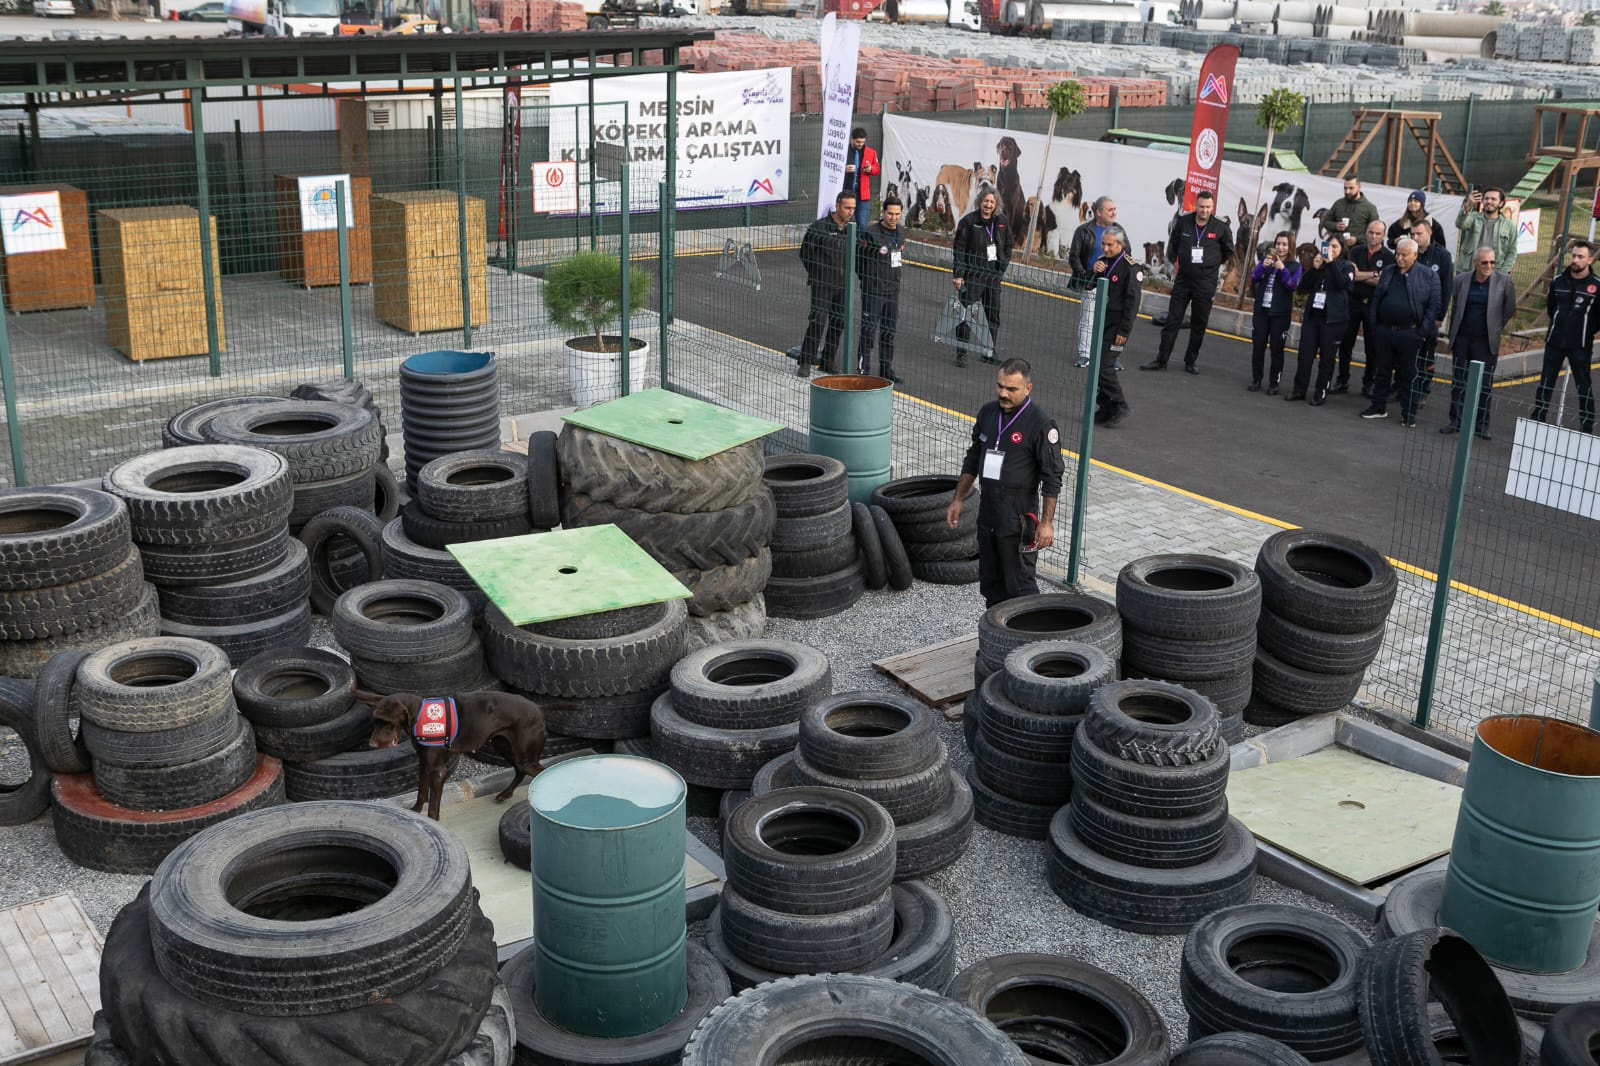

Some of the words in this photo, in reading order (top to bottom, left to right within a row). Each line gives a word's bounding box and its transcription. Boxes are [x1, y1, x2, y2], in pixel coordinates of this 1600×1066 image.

[685, 120, 757, 138] ARAMA
[686, 140, 781, 164] ÇALIŞTAYI
[661, 169, 692, 179] 222
